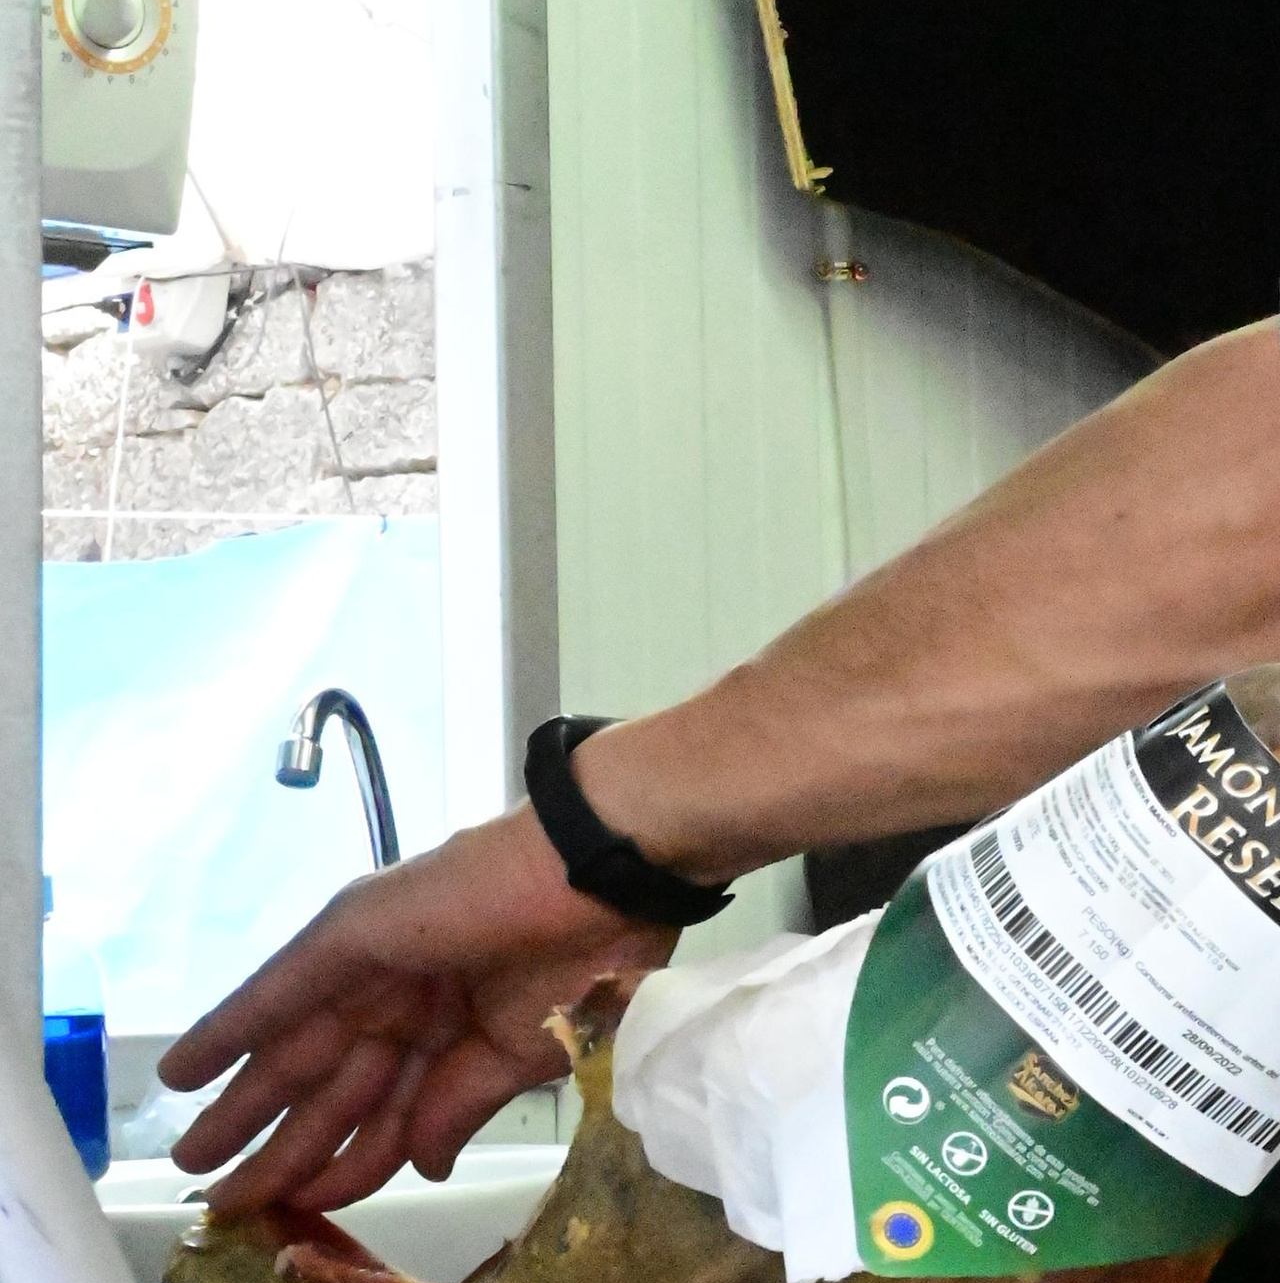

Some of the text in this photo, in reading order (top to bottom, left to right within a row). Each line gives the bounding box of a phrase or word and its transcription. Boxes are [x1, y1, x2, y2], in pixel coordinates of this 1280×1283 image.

[1149, 804, 1178, 838] MAKRO
[1082, 905, 1133, 960] PESO(kg)
[1135, 960, 1174, 1002] Consumir
[925, 1036, 946, 1060] Para
[1182, 1027, 1243, 1078] 28/09/2022
[909, 1144, 973, 1206] SIN LACTOSA
[977, 1208, 1039, 1256] SIN GLUTEN
